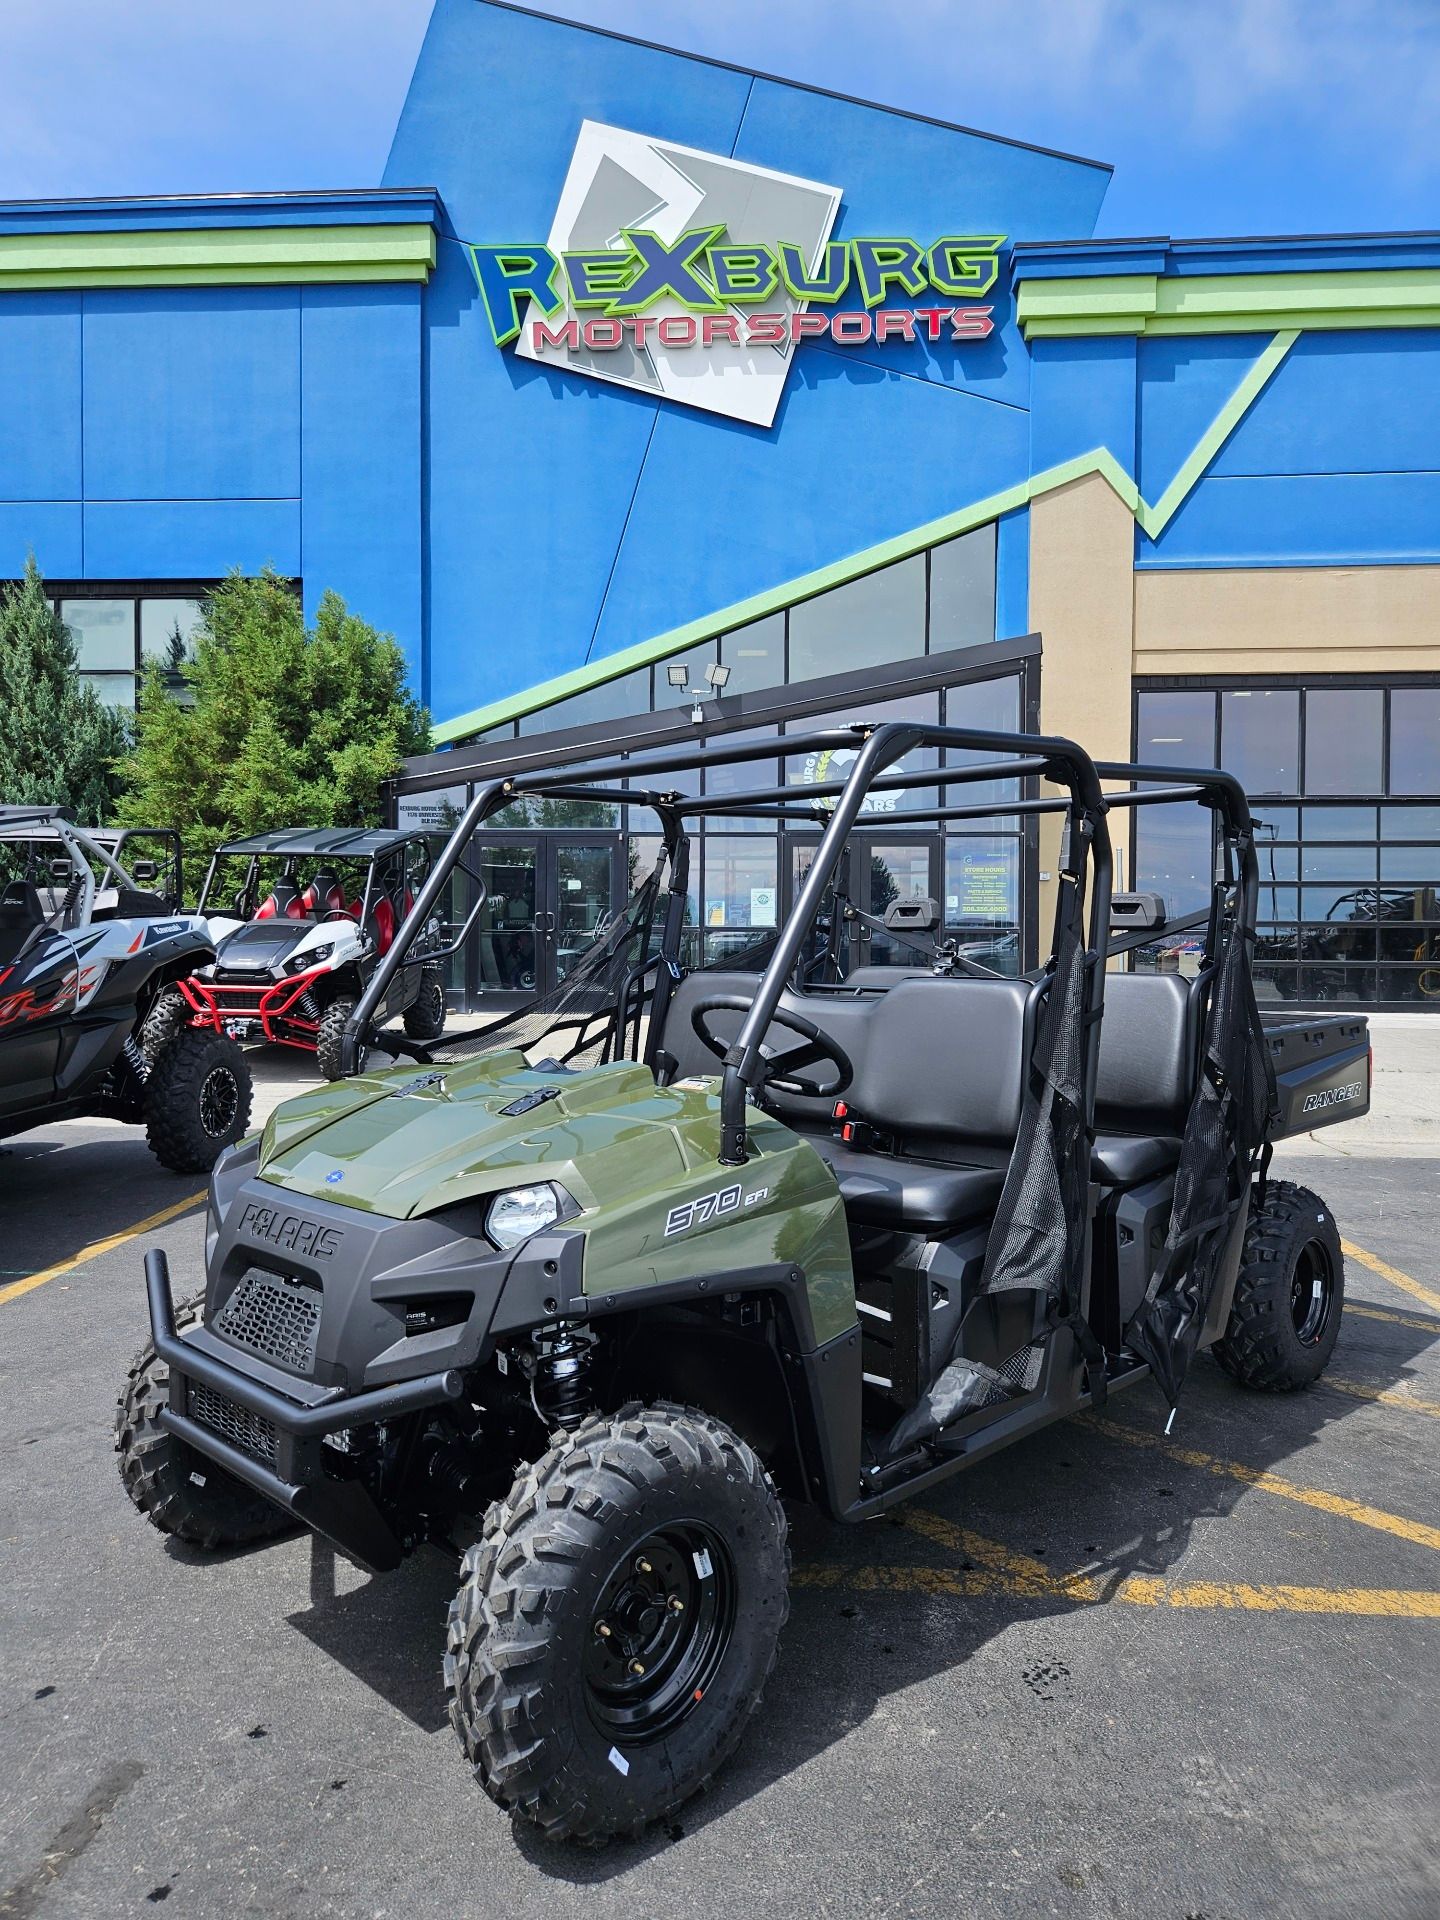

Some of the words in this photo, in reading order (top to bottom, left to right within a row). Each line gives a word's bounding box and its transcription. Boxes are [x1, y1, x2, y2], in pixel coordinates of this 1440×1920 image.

[470, 224, 1008, 347] REXBURG
[533, 306, 996, 353] MOTORSPORTS
[152, 923, 183, 935] Kawasaki
[1302, 1081, 1362, 1113] RANGER
[237, 1203, 345, 1259] POLARIS
[664, 1184, 742, 1236] 570
[744, 1187, 769, 1206] EFI
